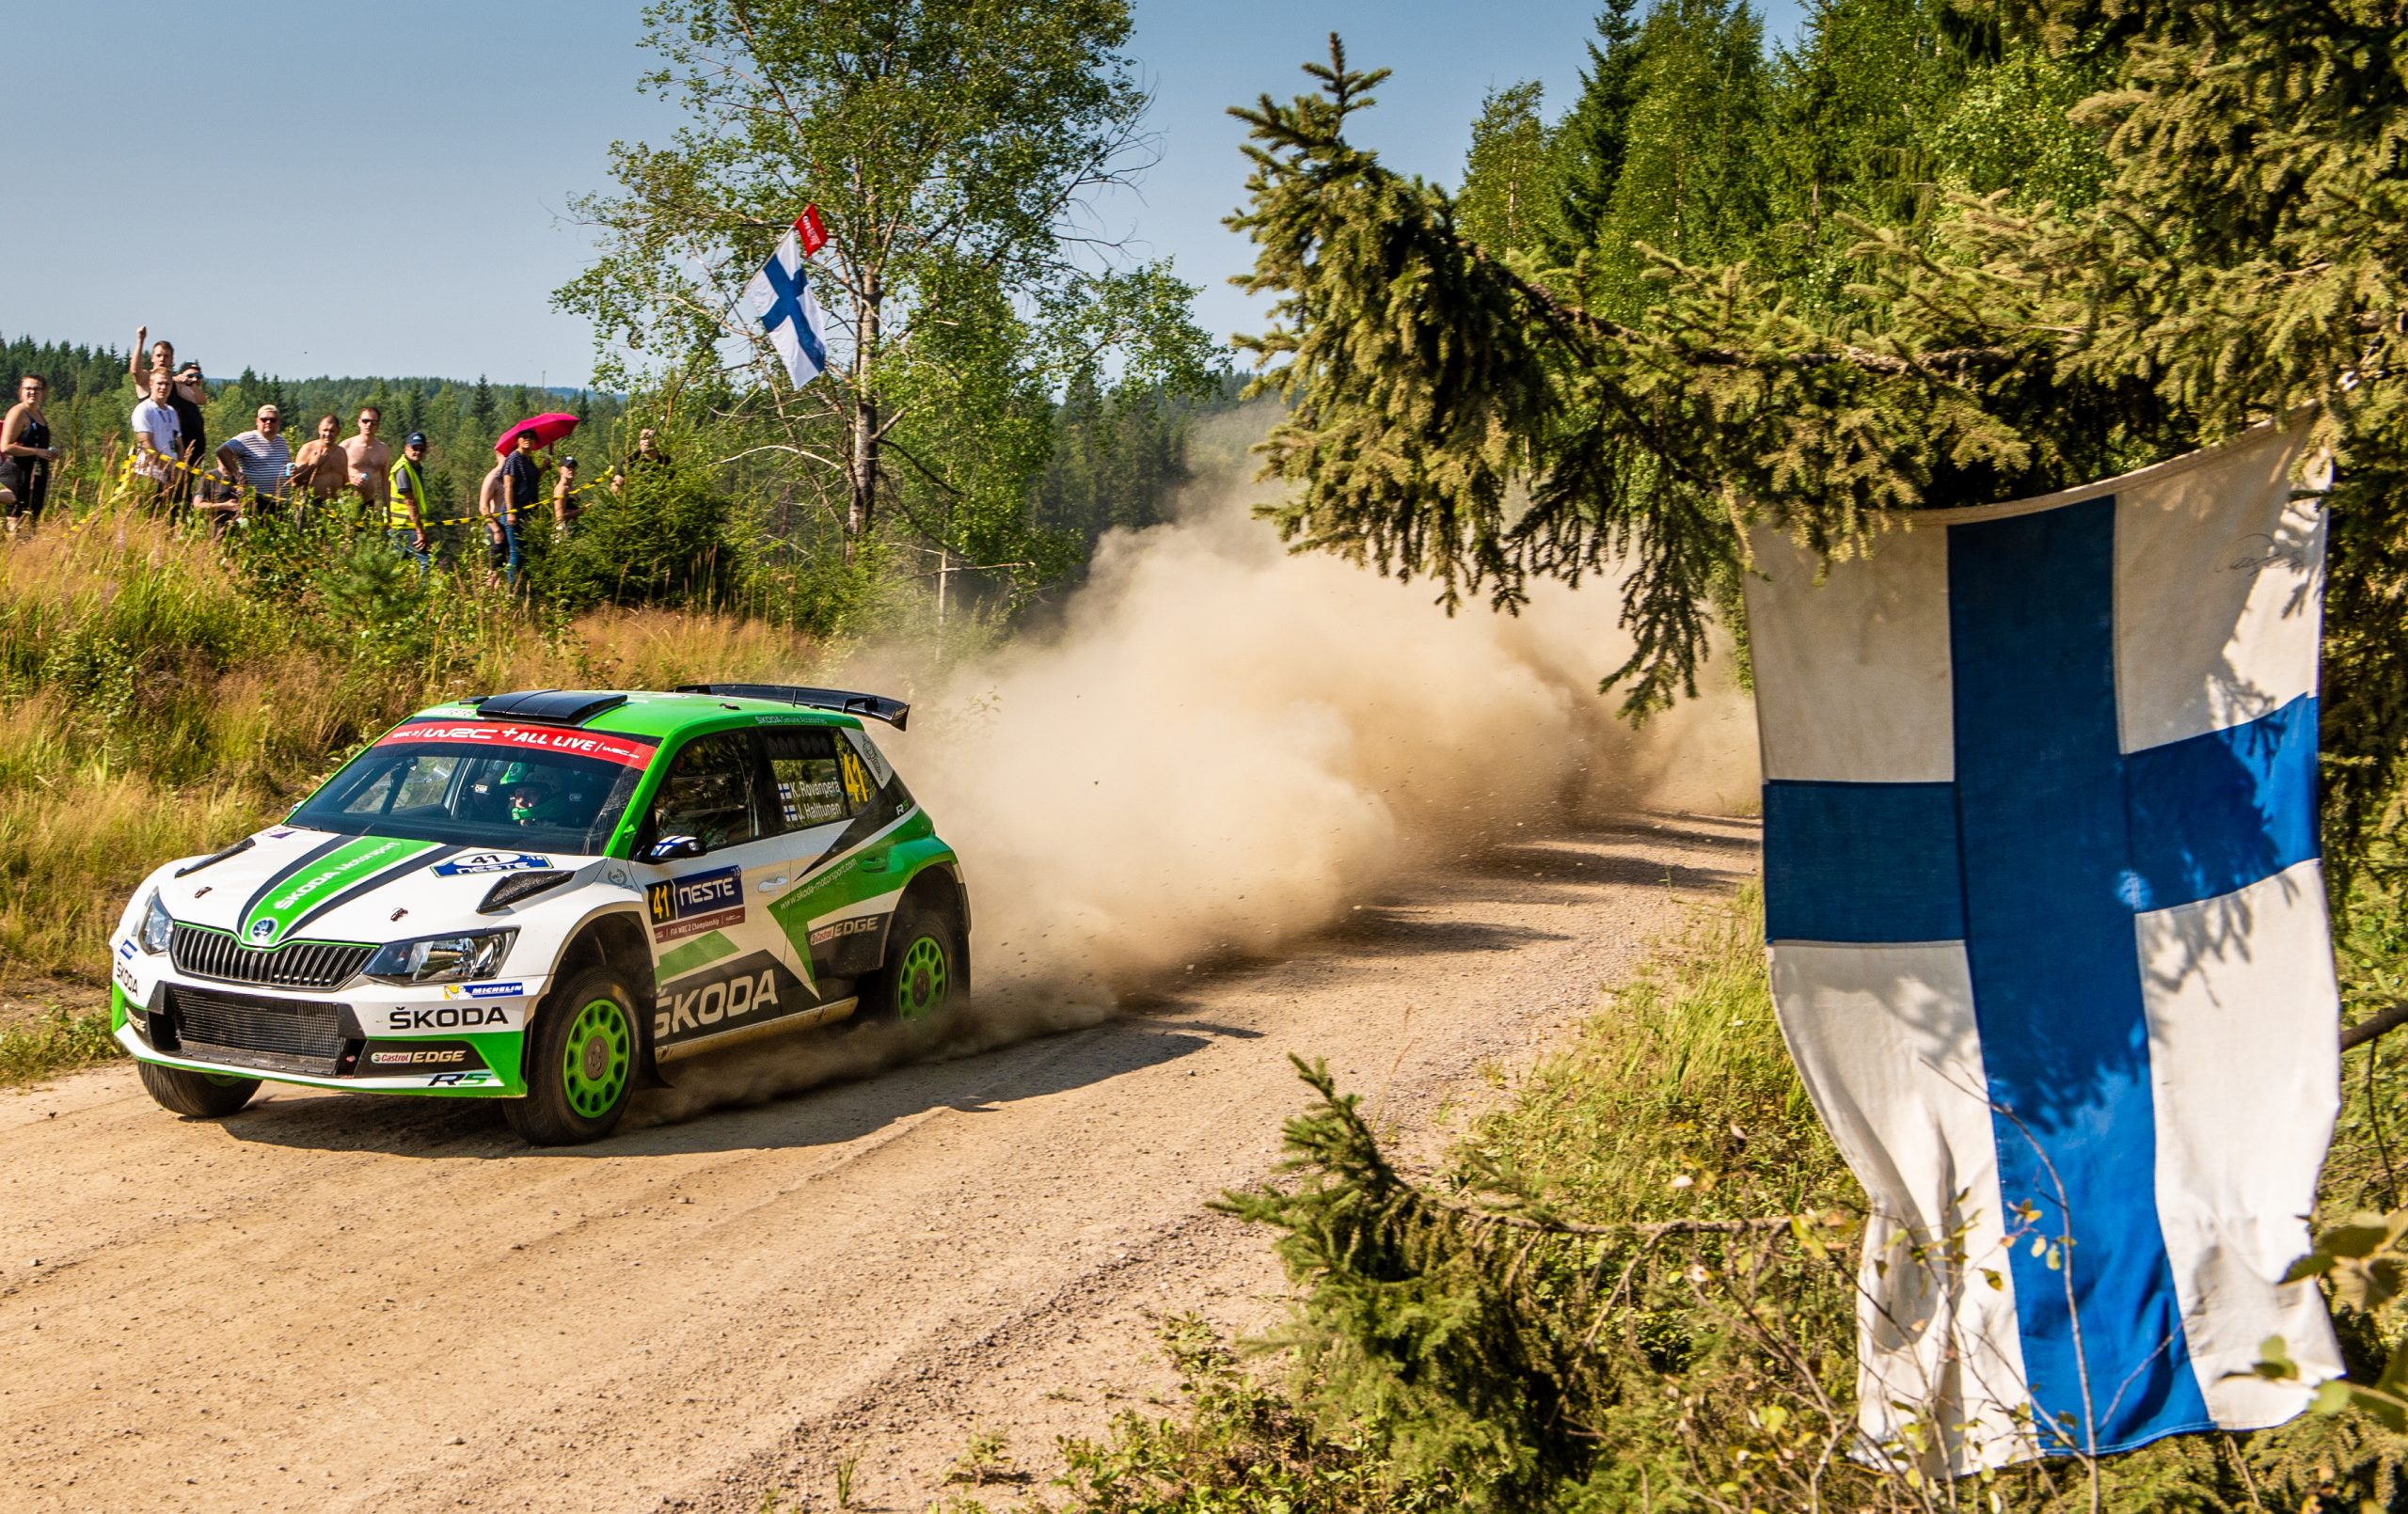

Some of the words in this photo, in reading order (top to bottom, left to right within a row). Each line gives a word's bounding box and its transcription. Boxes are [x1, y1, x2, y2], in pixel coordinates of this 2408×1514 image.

[552, 735, 597, 751] LIVE
[843, 753, 868, 802] 41
[790, 781, 801, 798] K.
[799, 777, 841, 798] Rovanperä
[798, 803, 806, 820] J.
[804, 802, 842, 820] Halttunen
[895, 799, 910, 816] R5
[471, 854, 500, 864] 41
[456, 862, 531, 875] NESTE
[679, 877, 736, 907] NESTE
[653, 885, 671, 919] 41
[833, 916, 879, 938] EDGE
[471, 985, 523, 995] MICHELIN
[389, 1006, 509, 1030] ŠKODA
[381, 1052, 409, 1064] Castrol
[411, 1049, 467, 1064] EDGE
[427, 1073, 493, 1087] R5
